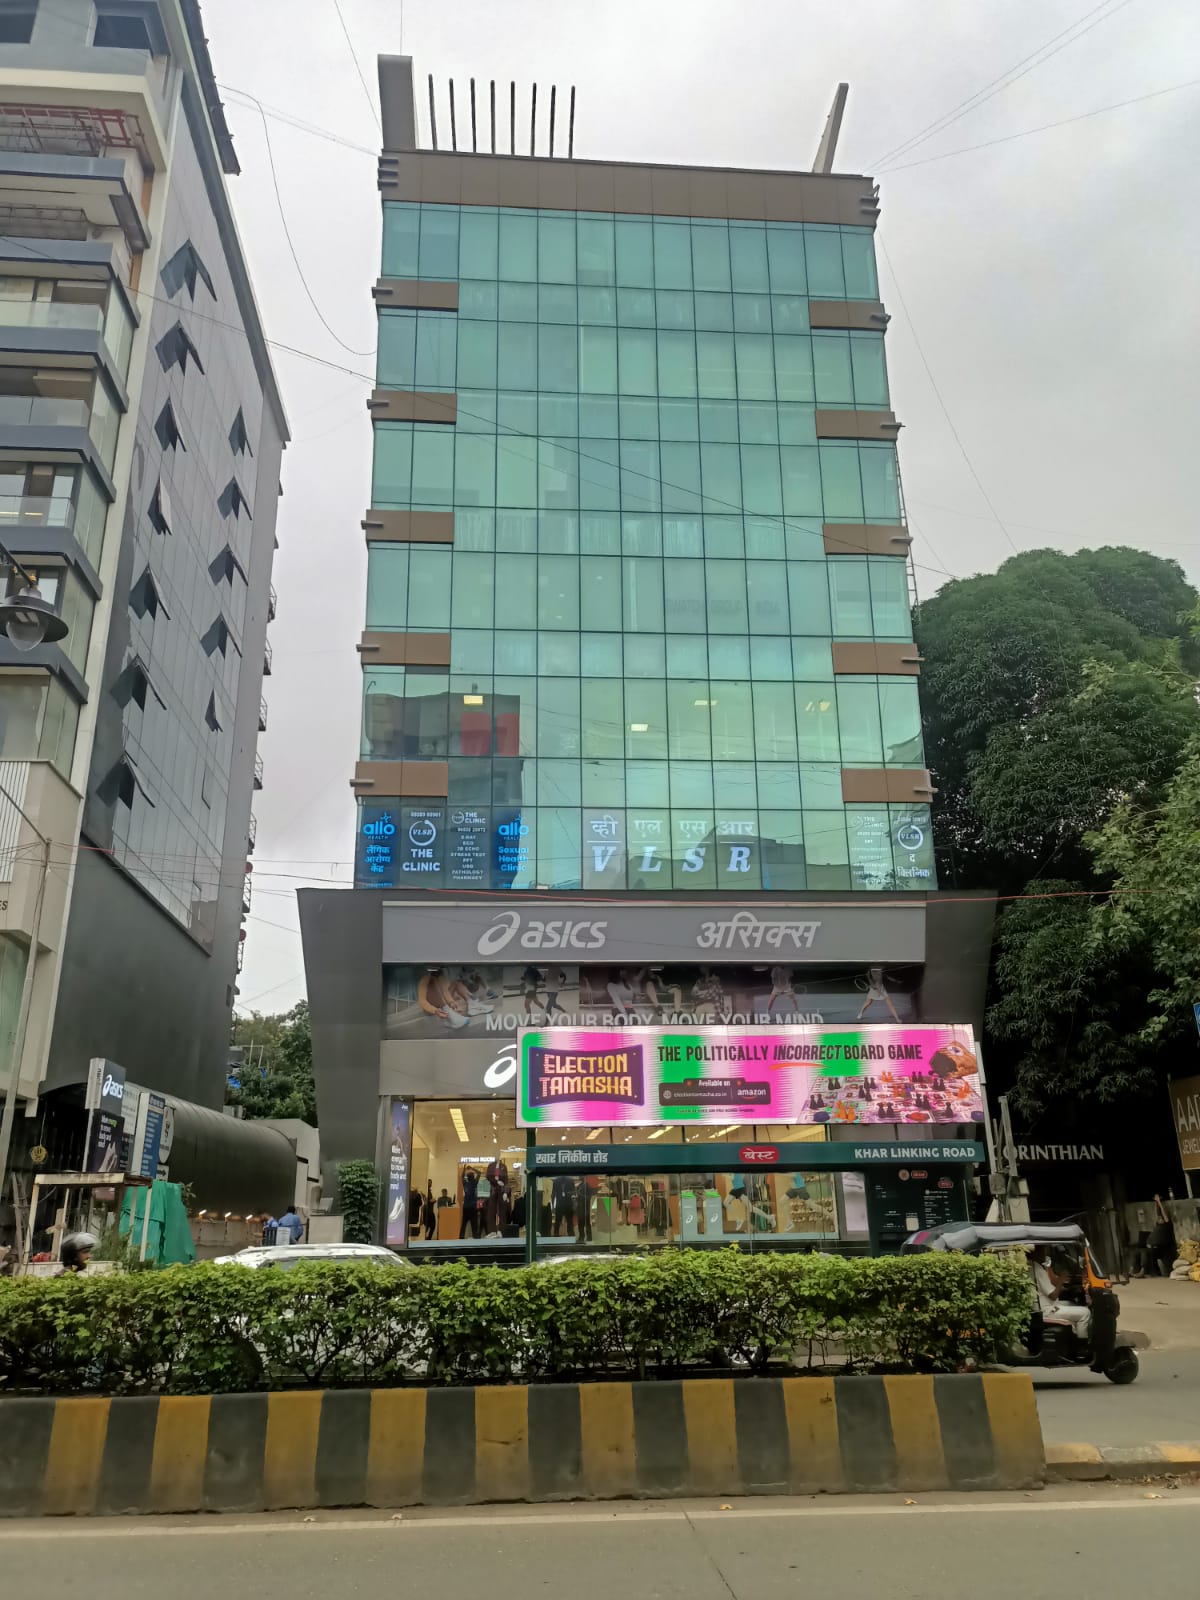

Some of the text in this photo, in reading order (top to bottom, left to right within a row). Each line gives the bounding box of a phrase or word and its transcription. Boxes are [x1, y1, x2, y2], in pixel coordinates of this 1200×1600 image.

[363, 821, 395, 835] allo
[498, 822, 529, 835] allo
[633, 819, 663, 836] एल
[679, 819, 707, 837] एस
[410, 848, 433, 858] THE
[498, 846, 529, 854] Sexual
[591, 846, 752, 872] V L S R
[402, 862, 441, 872] CLINIC
[696, 911, 822, 948] असिक्स
[486, 1013, 541, 1031] MOVE
[547, 1013, 597, 1026] YOUR
[602, 1013, 653, 1025] BODY
[662, 1013, 715, 1025] MOVE
[720, 1013, 771, 1025] YOUR
[657, 1044, 923, 1061] THE POLITICALLY INCORRECT BOARD GAME
[539, 1076, 632, 1097] TAMASHA
[737, 1088, 767, 1096] amazon
[854, 1148, 975, 1159] KHAR LINKING ROAD
